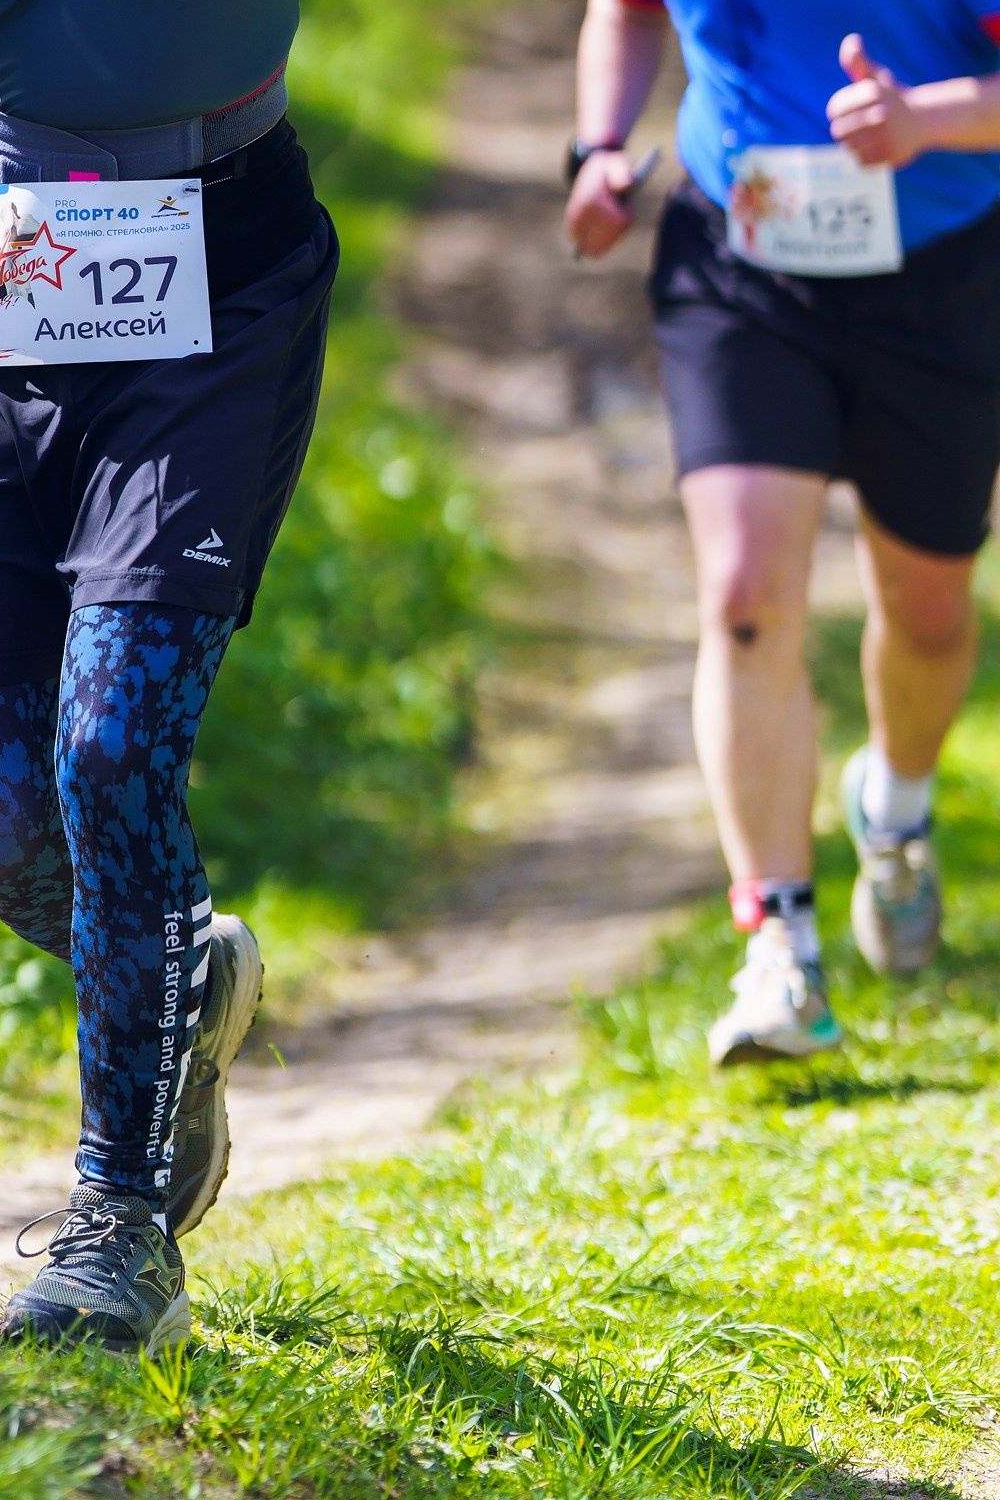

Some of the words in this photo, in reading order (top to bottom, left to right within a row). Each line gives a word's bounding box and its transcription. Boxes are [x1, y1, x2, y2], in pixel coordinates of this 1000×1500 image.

[55, 200, 77, 208] PRO
[55, 208, 114, 221] СПОРТ
[117, 207, 139, 220] 40
[106, 226, 169, 237] СТРЕЛКОВКА»
[170, 222, 191, 232] 2025
[79, 255, 178, 306] 127
[34, 311, 166, 341] Алексей
[182, 548, 232, 567] DEMIX
[164, 911, 185, 954] feel
[158, 961, 182, 1029] strong
[160, 1035, 176, 1072] and
[147, 1079, 171, 1159] powerfu
